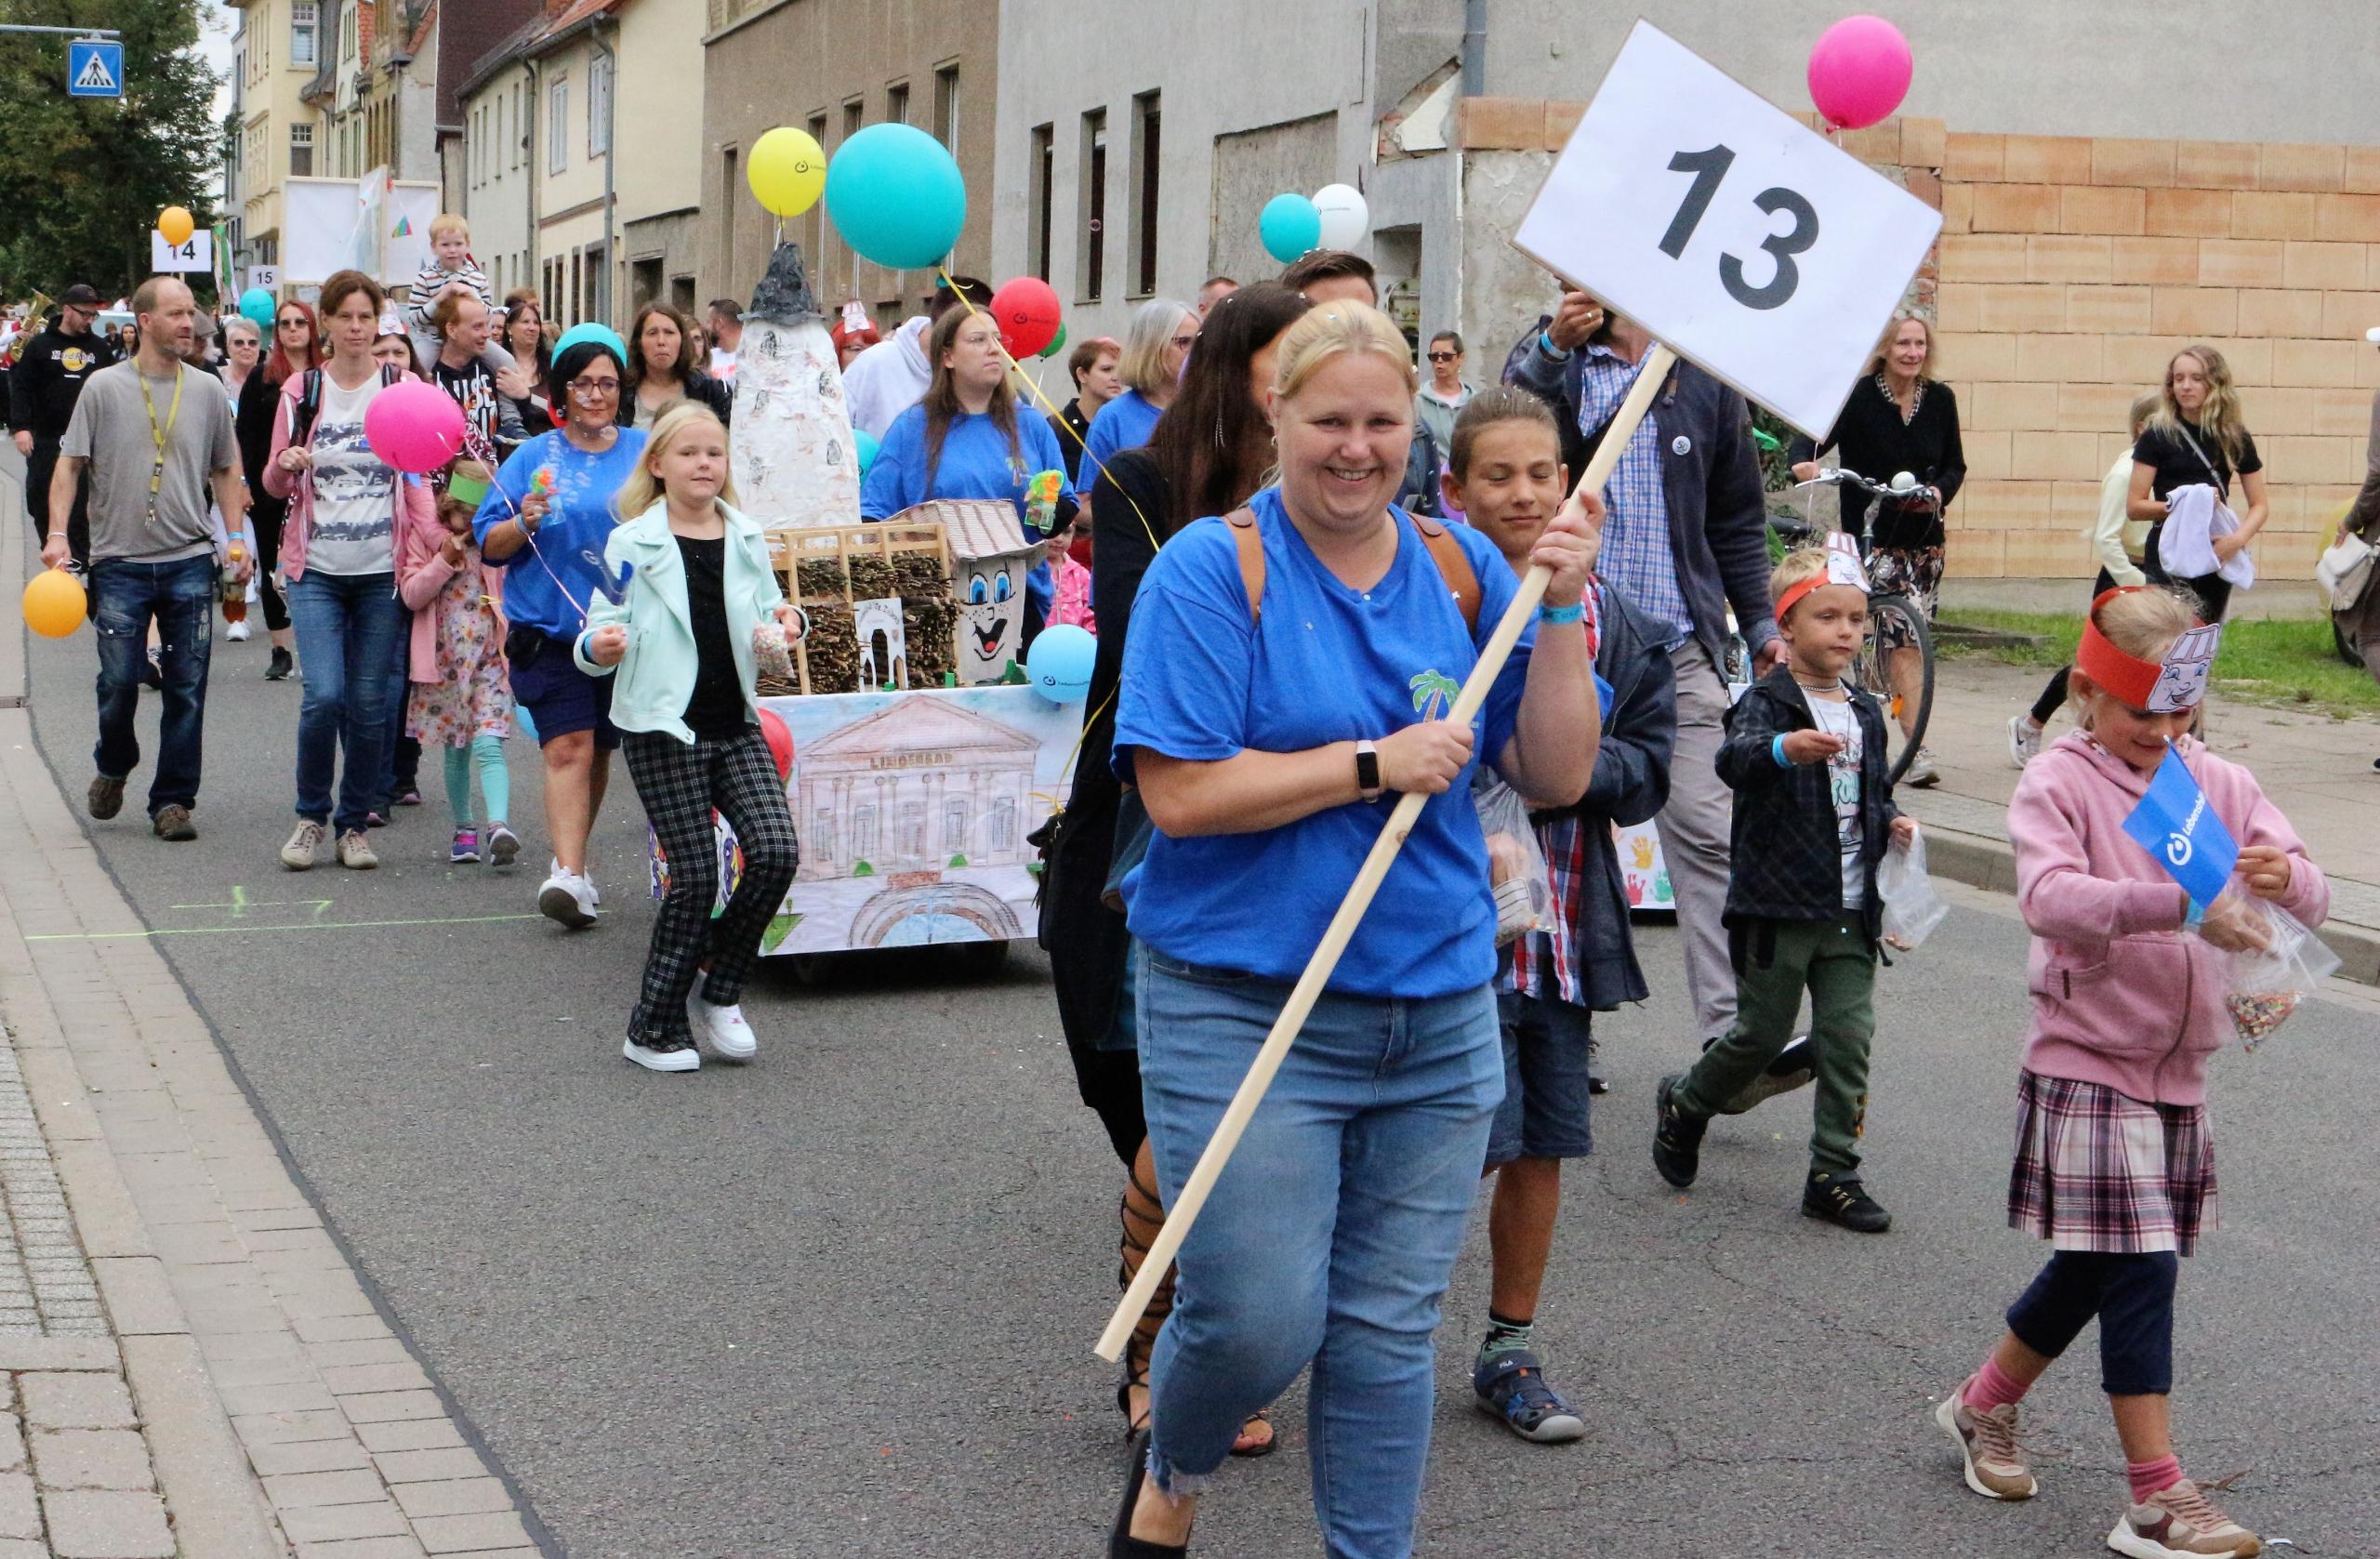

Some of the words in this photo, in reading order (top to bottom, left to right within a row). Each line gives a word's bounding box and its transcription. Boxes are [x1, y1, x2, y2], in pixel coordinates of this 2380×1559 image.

[1658, 143, 1819, 310] 13
[167, 240, 196, 260] 14
[257, 271, 273, 284] 15
